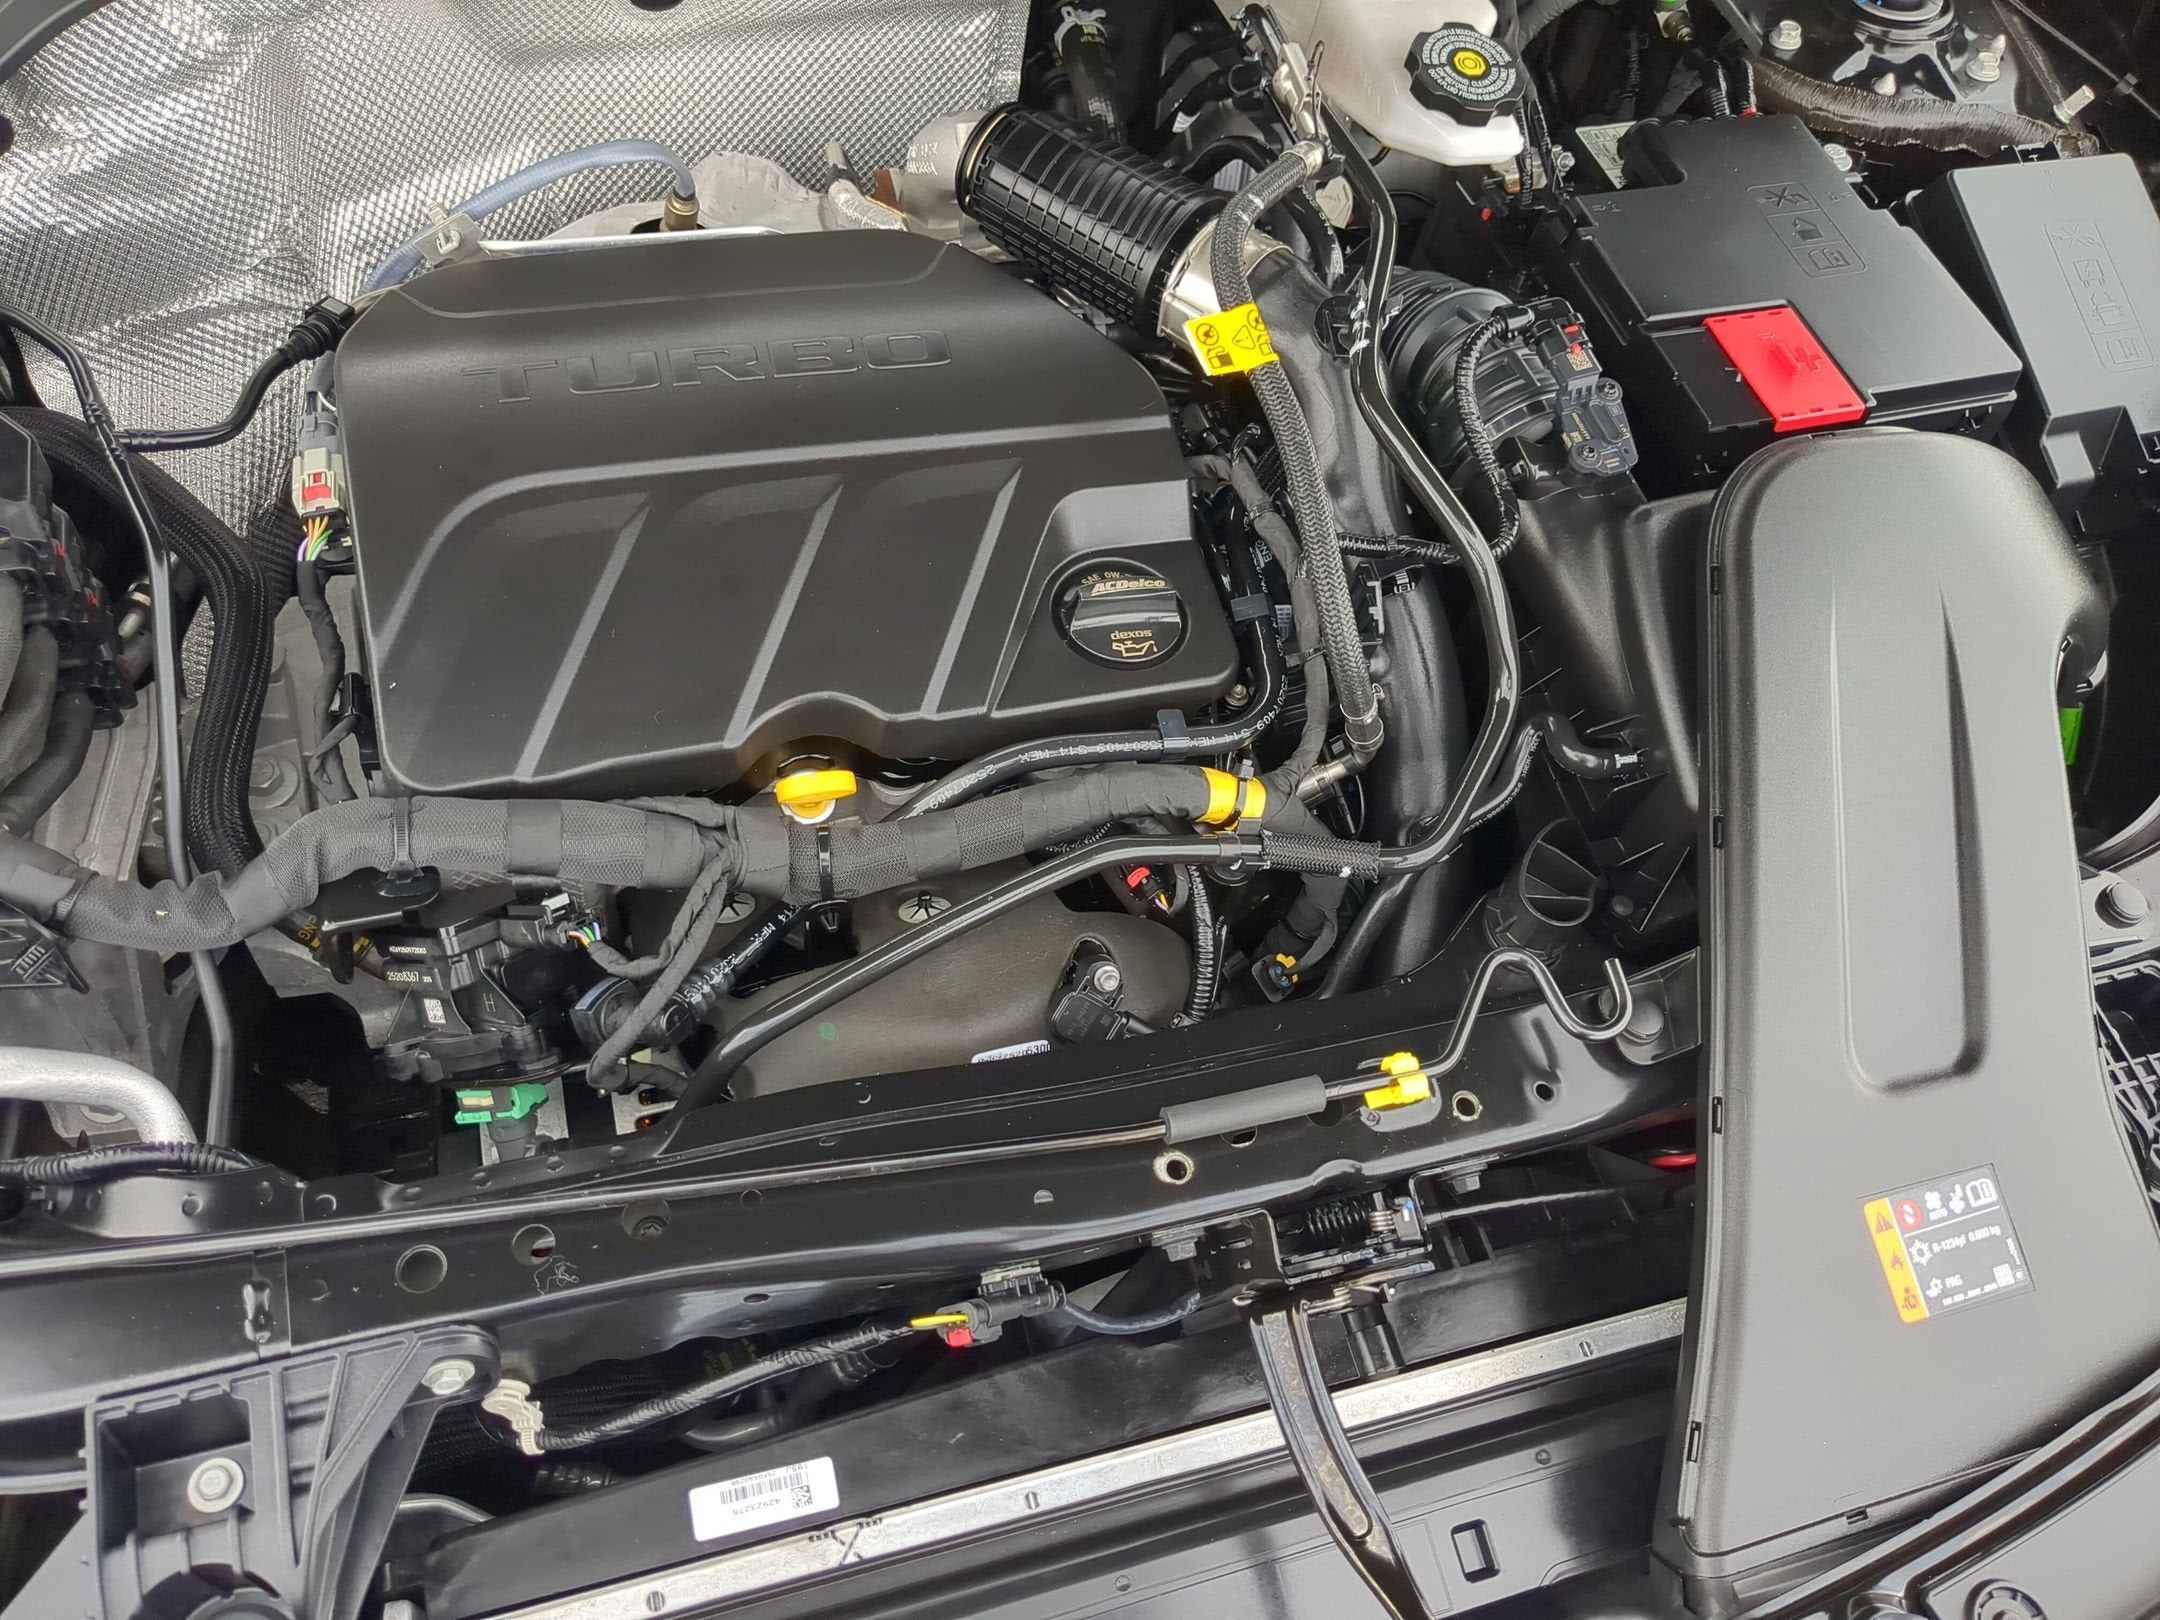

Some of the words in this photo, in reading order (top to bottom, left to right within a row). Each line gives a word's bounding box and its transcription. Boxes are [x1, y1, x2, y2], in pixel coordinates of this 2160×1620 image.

[461, 329, 952, 404] TURBO
[1081, 573, 1102, 586] SAE
[1091, 578, 1166, 594] ACDelco
[1110, 629, 1153, 640] dexos
[1018, 748, 1050, 764] MEX
[483, 993, 496, 1012] H
[1944, 1274, 1964, 1289] PAG
